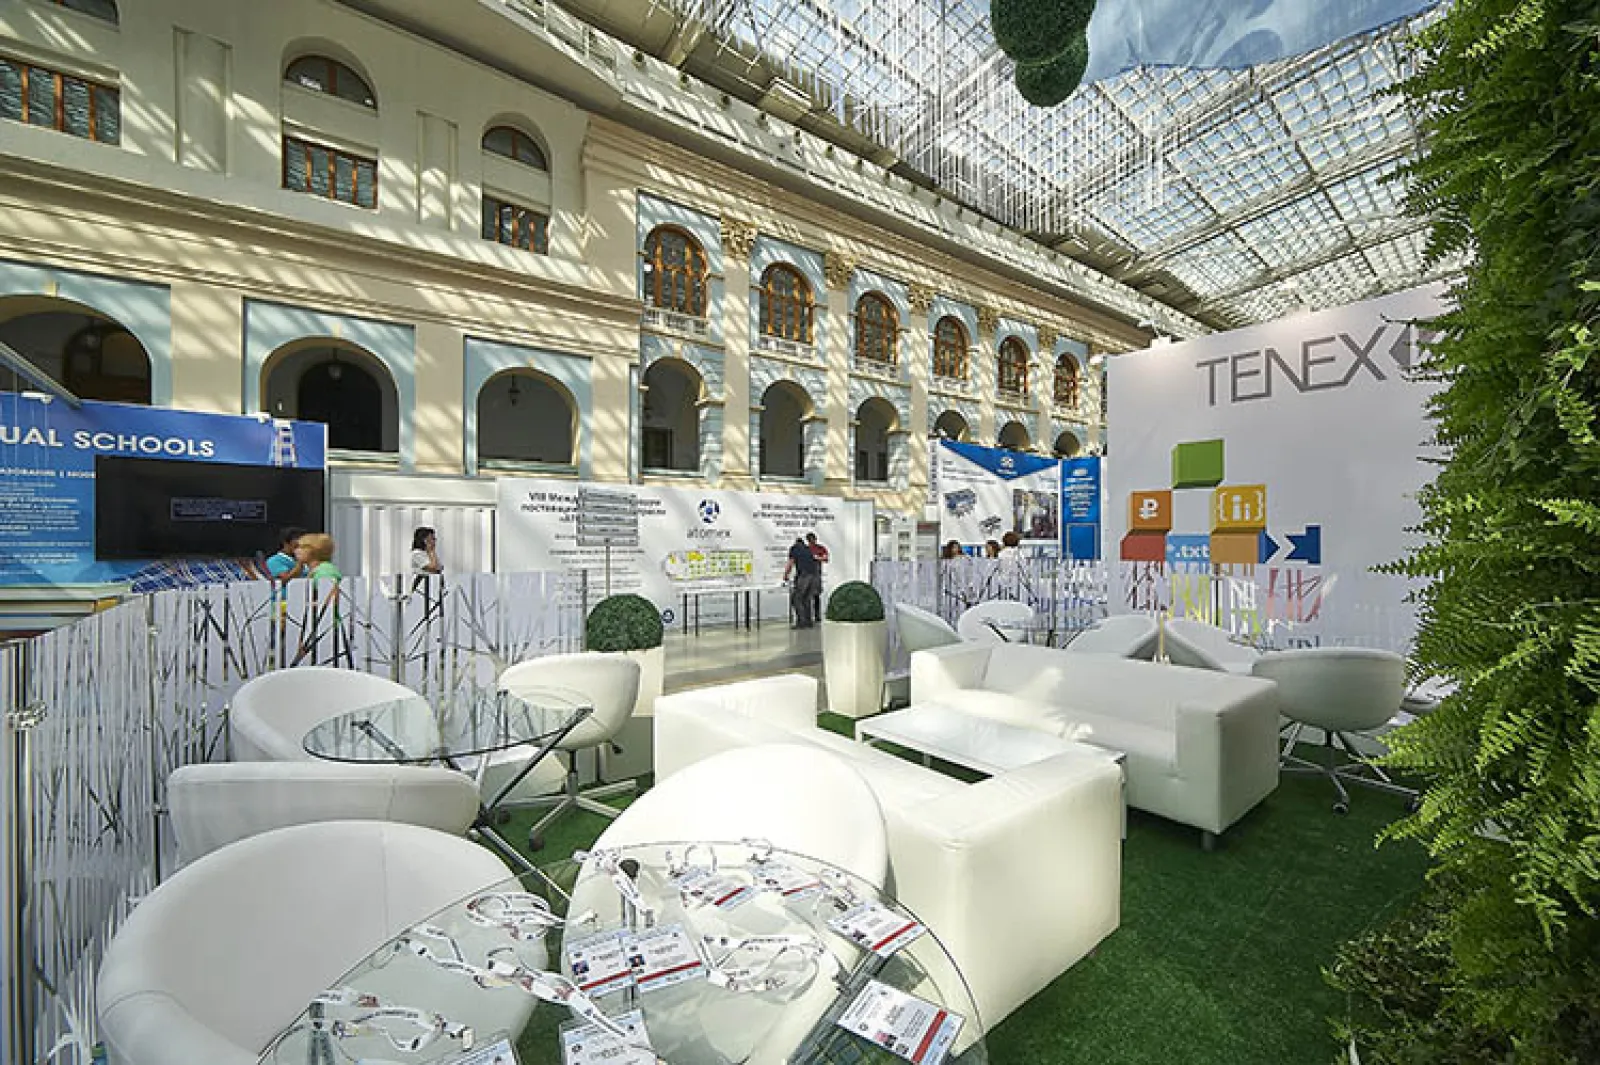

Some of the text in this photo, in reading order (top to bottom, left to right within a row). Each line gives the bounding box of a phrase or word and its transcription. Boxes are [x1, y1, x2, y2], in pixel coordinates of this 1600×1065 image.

[1196, 326, 1388, 406] TENEX
[74, 431, 215, 457] SCHOOLS
[687, 527, 732, 539] atomex
